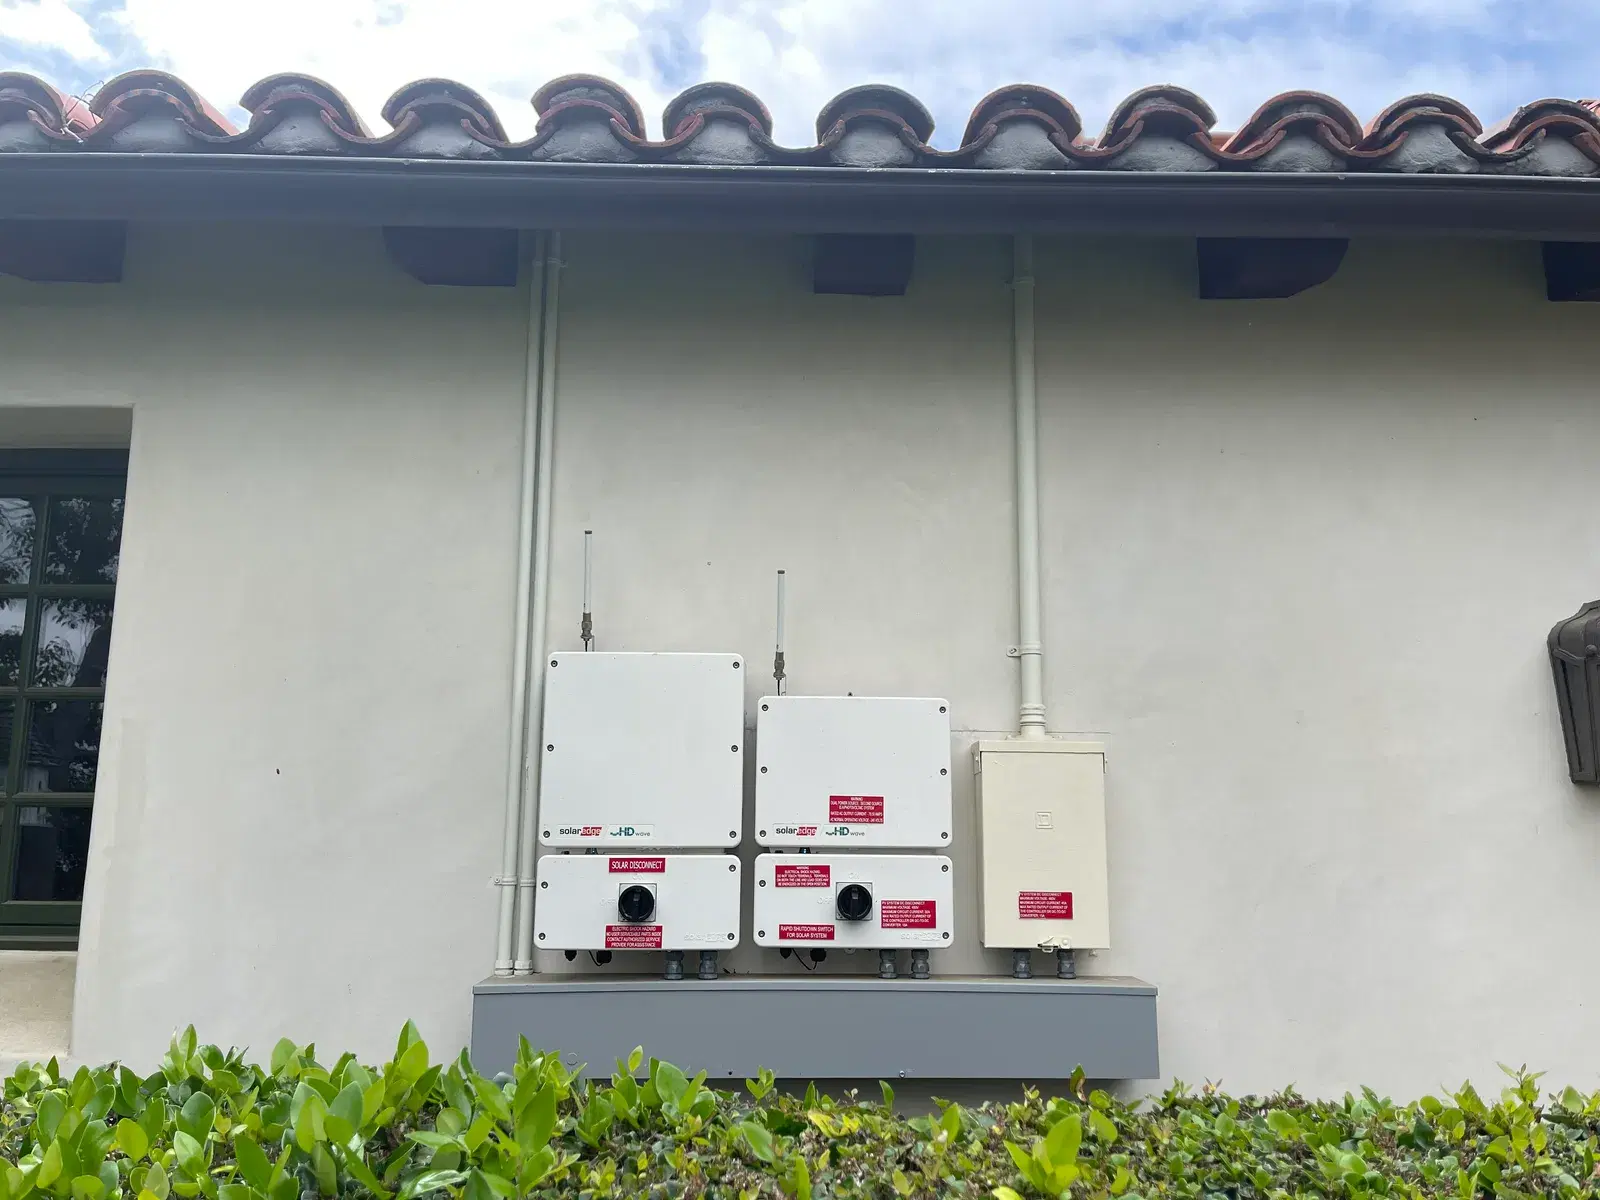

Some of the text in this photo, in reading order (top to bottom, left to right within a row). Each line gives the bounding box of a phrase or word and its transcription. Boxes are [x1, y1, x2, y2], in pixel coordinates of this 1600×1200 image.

[560, 826, 602, 836] solaredge
[620, 826, 634, 836] HD
[776, 826, 817, 836] solaredge
[834, 826, 849, 836] HD
[612, 861, 663, 869] SOLAR DISCONNECT
